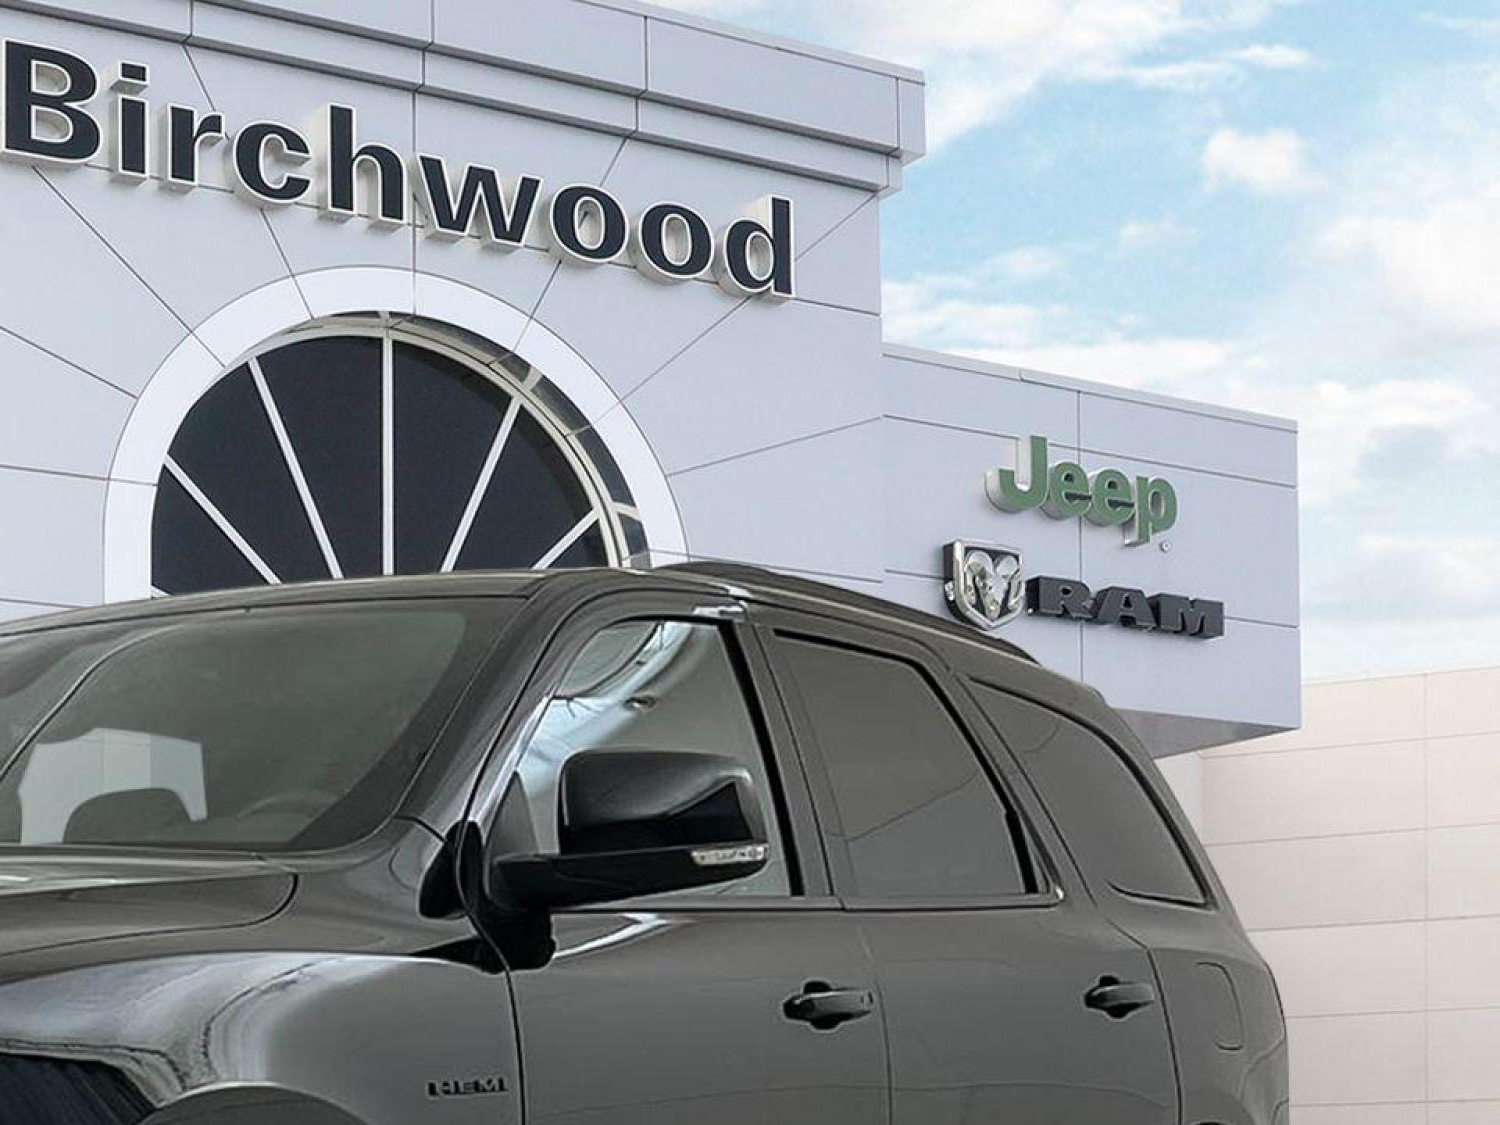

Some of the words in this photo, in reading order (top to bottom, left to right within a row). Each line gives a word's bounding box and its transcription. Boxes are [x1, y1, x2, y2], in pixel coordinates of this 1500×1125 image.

[0, 39, 795, 300] Birchwood
[986, 435, 1178, 546] Jeep
[1026, 576, 1224, 638] RAM
